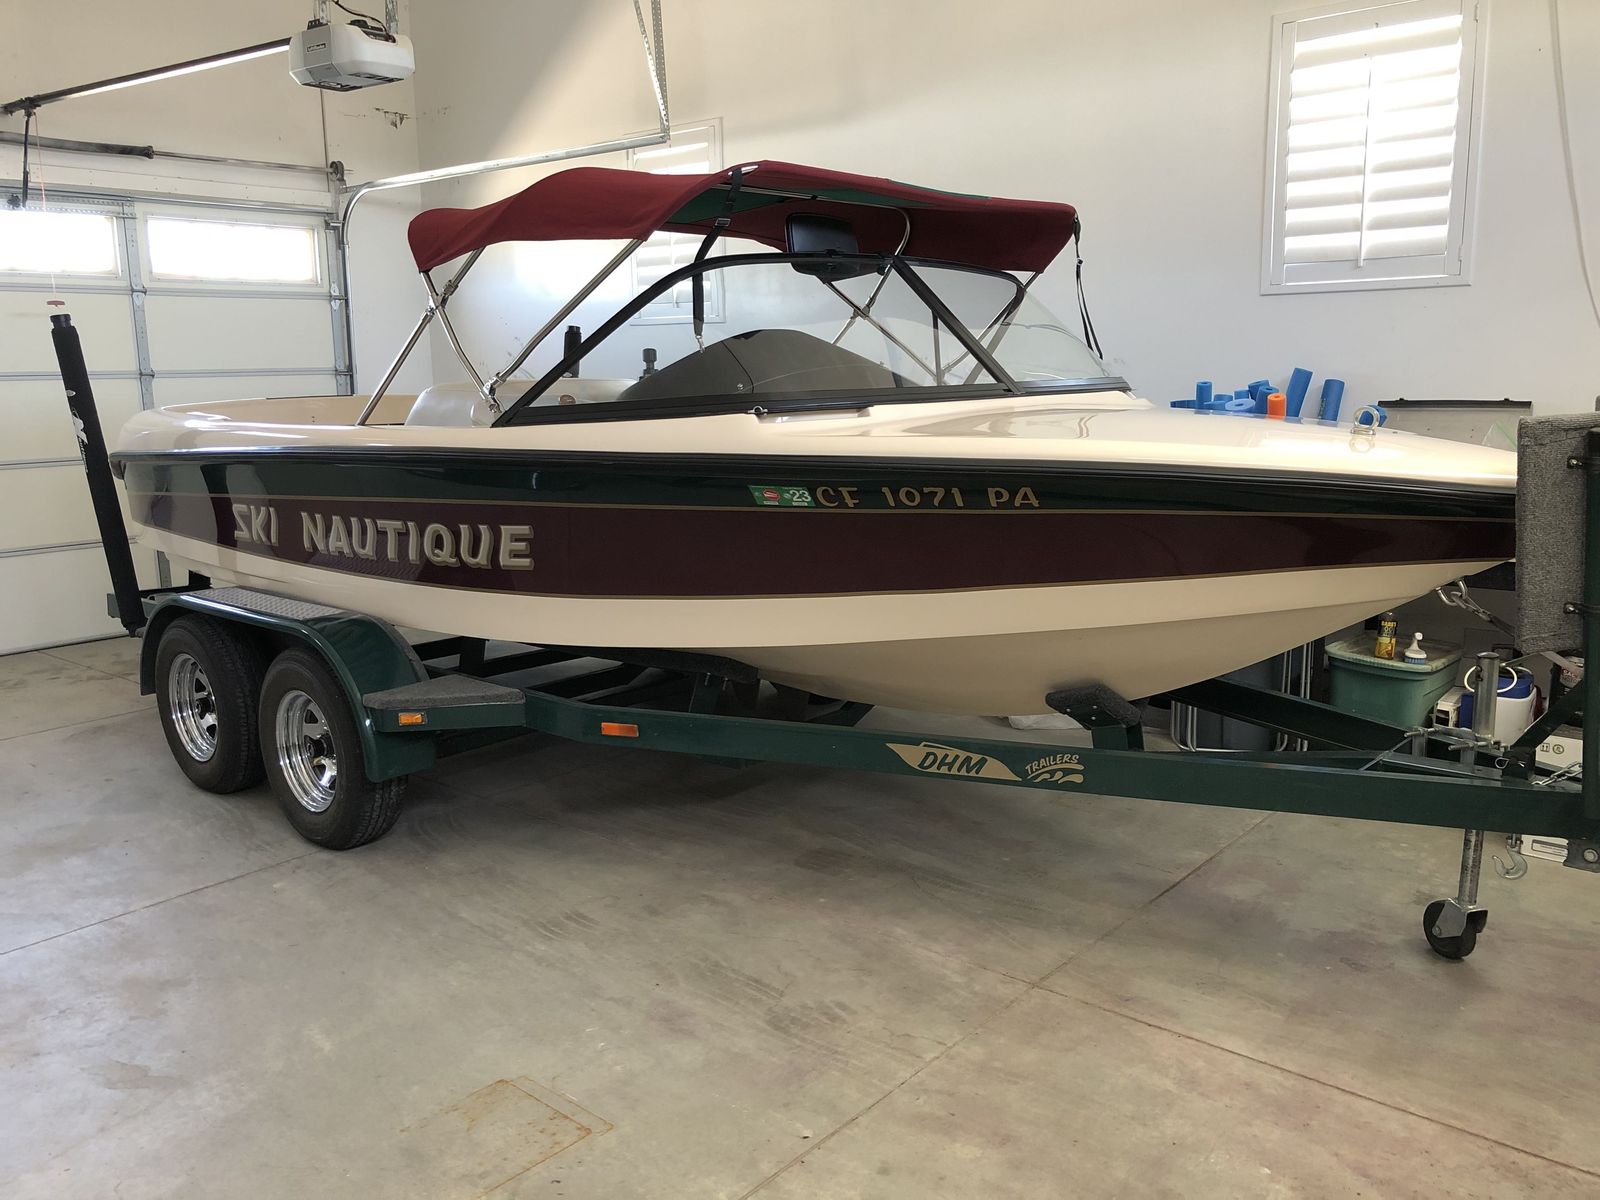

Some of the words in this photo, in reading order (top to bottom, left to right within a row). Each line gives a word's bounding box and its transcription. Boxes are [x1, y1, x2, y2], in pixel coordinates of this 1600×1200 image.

[790, 489, 811, 502] 23
[815, 486, 859, 508] CF
[881, 487, 964, 507] 1071
[987, 487, 1040, 508] PA
[232, 503, 279, 547] SKI
[301, 511, 535, 571] NAUTIQUE
[917, 751, 988, 775] DHM
[1025, 753, 1080, 775] TRAILERS
